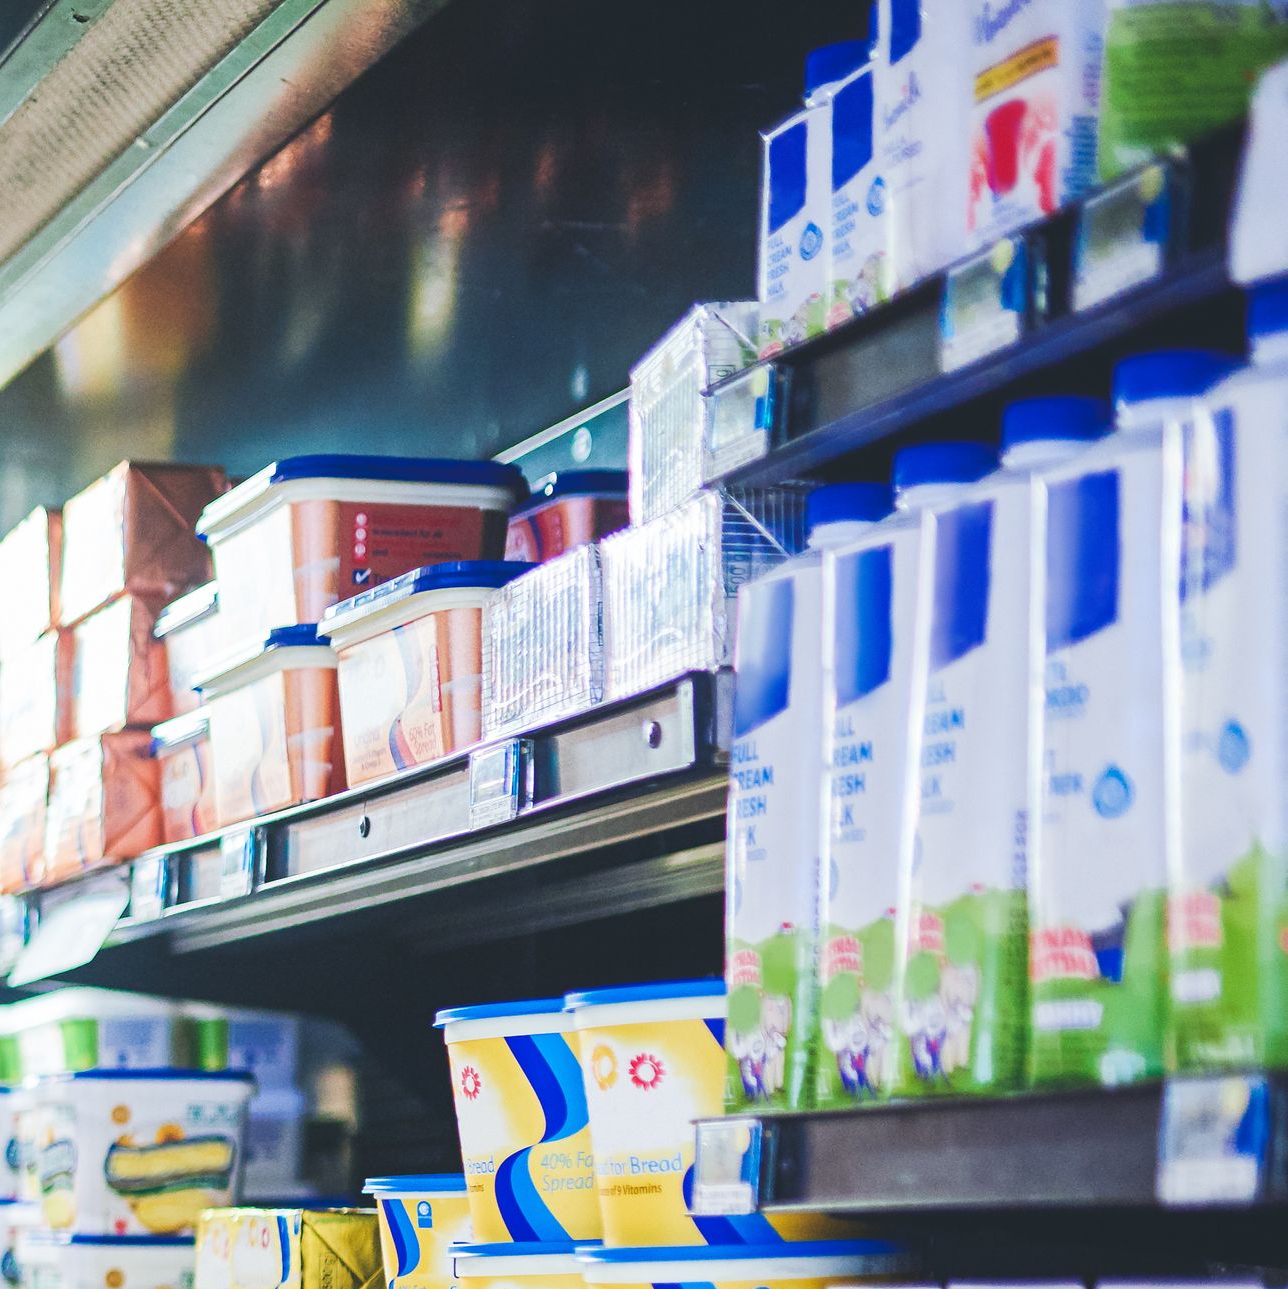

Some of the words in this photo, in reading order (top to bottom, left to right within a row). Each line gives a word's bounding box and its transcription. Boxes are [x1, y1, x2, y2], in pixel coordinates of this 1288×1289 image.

[540, 1152, 572, 1169] 40%
[577, 1151, 593, 1169] Fa
[630, 1153, 684, 1174] Bread
[623, 1183, 662, 1195] Vitamins
